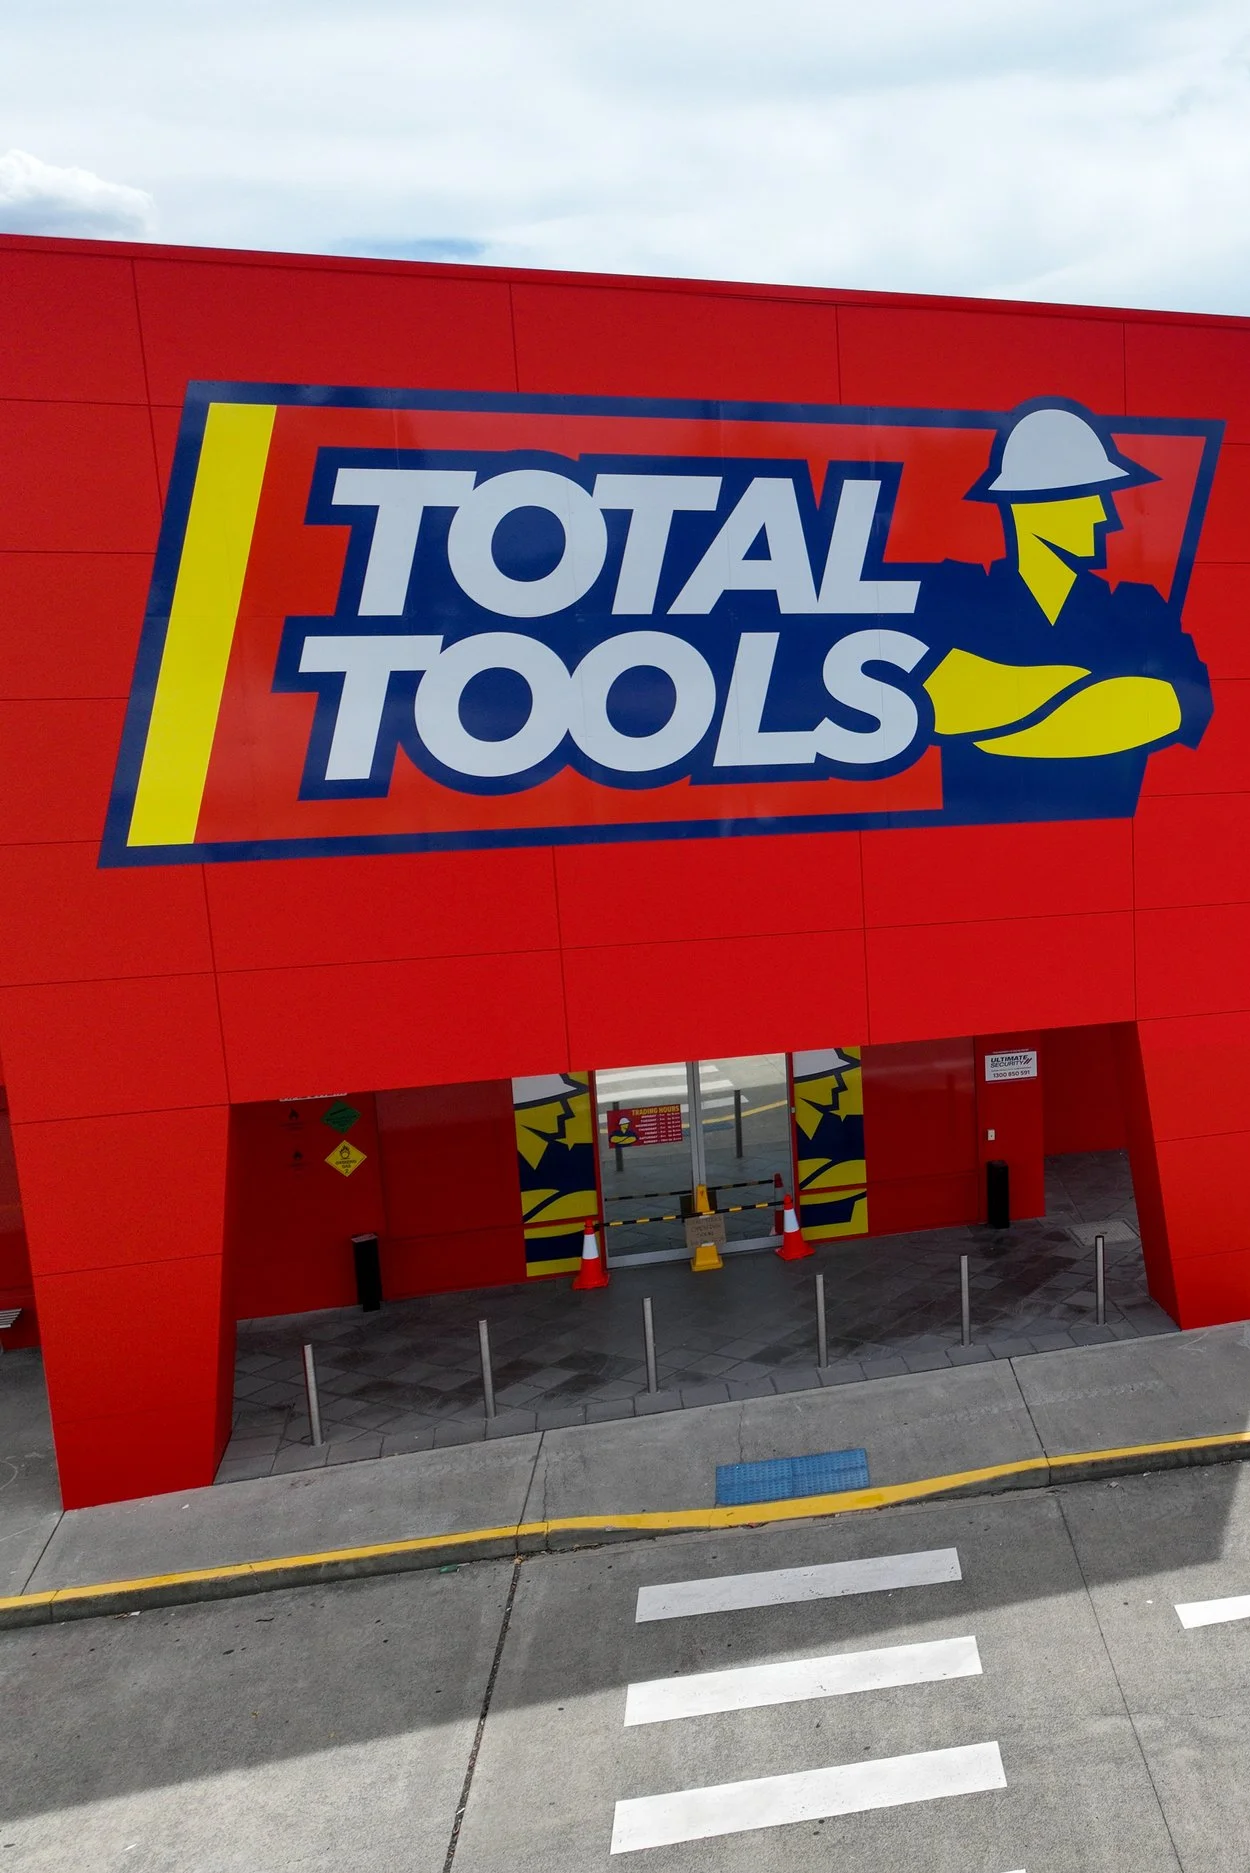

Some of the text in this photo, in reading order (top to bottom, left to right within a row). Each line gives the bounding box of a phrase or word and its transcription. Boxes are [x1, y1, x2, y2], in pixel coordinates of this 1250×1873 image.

[331, 468, 921, 618] TOTAL
[298, 629, 930, 781] TOOLS
[632, 1105, 680, 1116] TRADING HOURS
